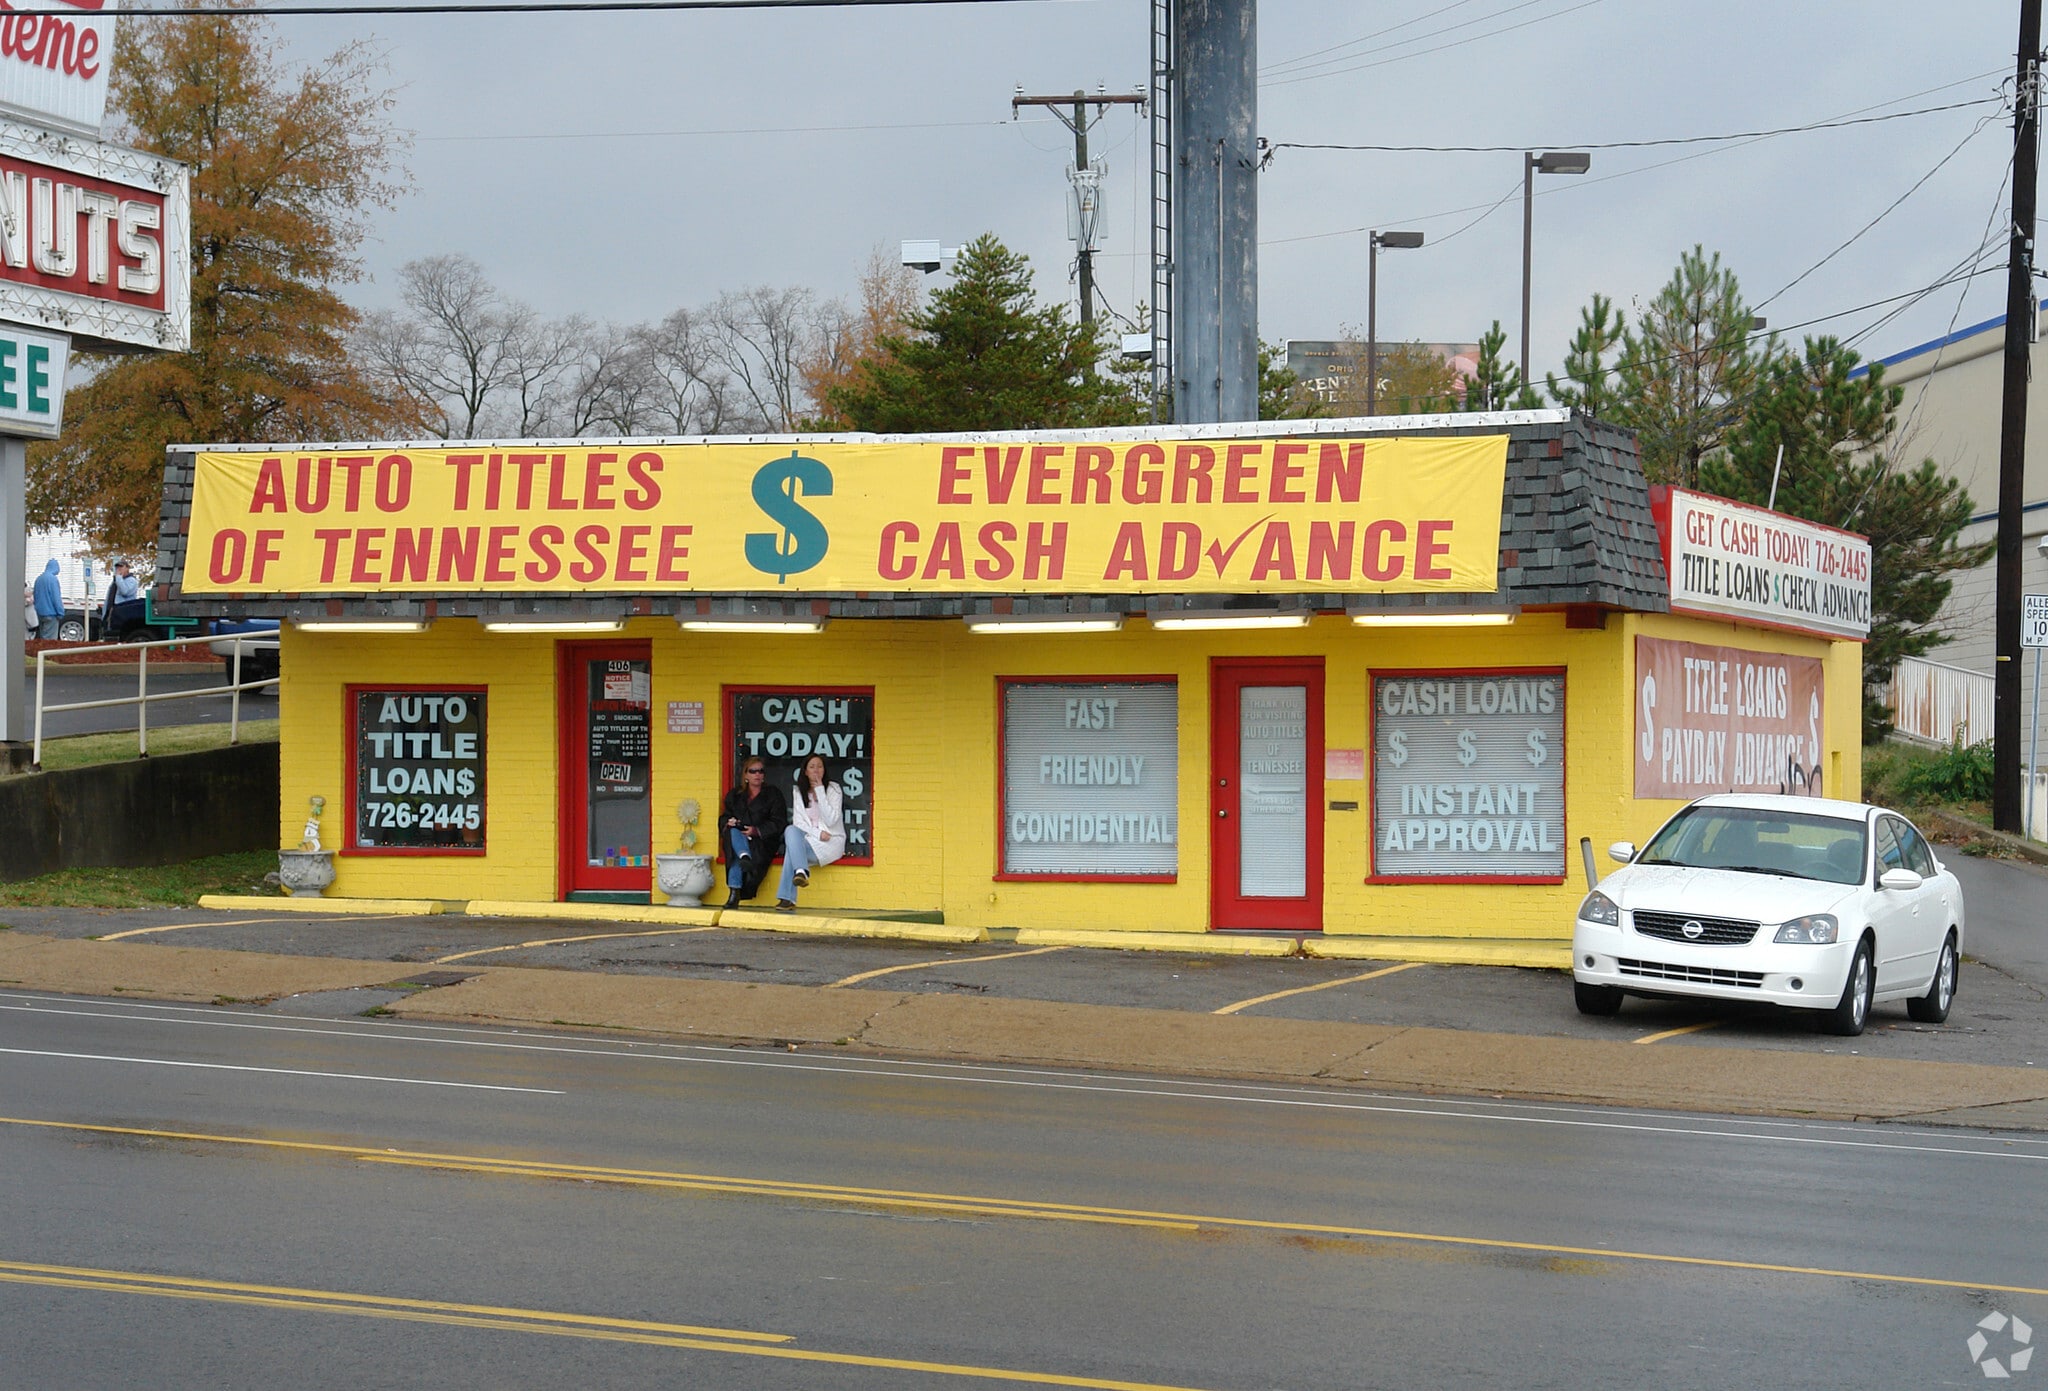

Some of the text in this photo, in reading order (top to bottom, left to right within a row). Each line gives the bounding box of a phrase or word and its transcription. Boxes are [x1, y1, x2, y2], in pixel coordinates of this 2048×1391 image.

[249, 452, 665, 514] AUTO TITLES
[937, 443, 1366, 506] EVERGREEN
[744, 450, 834, 584] $
[208, 524, 693, 585] OF TENNESSEE
[878, 520, 1069, 581] CASH
[1686, 509, 1868, 583] GET CASH TODAY! 726-2445
[1683, 553, 1720, 596] TITLE
[1726, 562, 1769, 605] LOANS
[1782, 574, 1818, 614] CHECK
[1822, 582, 1868, 625] ADVANCE
[2033, 621, 2047, 635] 10
[605, 674, 631, 682] NOTICE
[609, 661, 630, 671] 406
[1383, 681, 1556, 715] CASH LOANS
[1684, 657, 1787, 720] TITLE LOANS
[378, 696, 467, 724] AUTO
[762, 698, 849, 724] CASH
[1065, 699, 1119, 730] FAST
[1642, 668, 1656, 767] $
[368, 732, 478, 759] TITLE
[745, 731, 865, 758] TODAY!
[1244, 724, 1304, 739] AUTO TITLES
[1267, 743, 1280, 756] OF
[1388, 728, 1408, 769] $
[1456, 727, 1478, 769] $
[1526, 726, 1547, 769] $
[1662, 727, 1726, 785] PAYDAY
[1733, 732, 1804, 786] ADVANCE
[370, 767, 476, 798] LOAN$
[602, 763, 628, 781] OPEN
[842, 766, 864, 799] $
[1039, 755, 1144, 785] FRIENDLY
[1248, 760, 1301, 774] TENNESSEE
[613, 785, 643, 793] SMOKING
[1402, 783, 1540, 816] INSTANT
[366, 802, 480, 830] 726-2445
[1012, 811, 1174, 843] CONFIDENTIAL
[1384, 818, 1557, 852] APPROVAL
